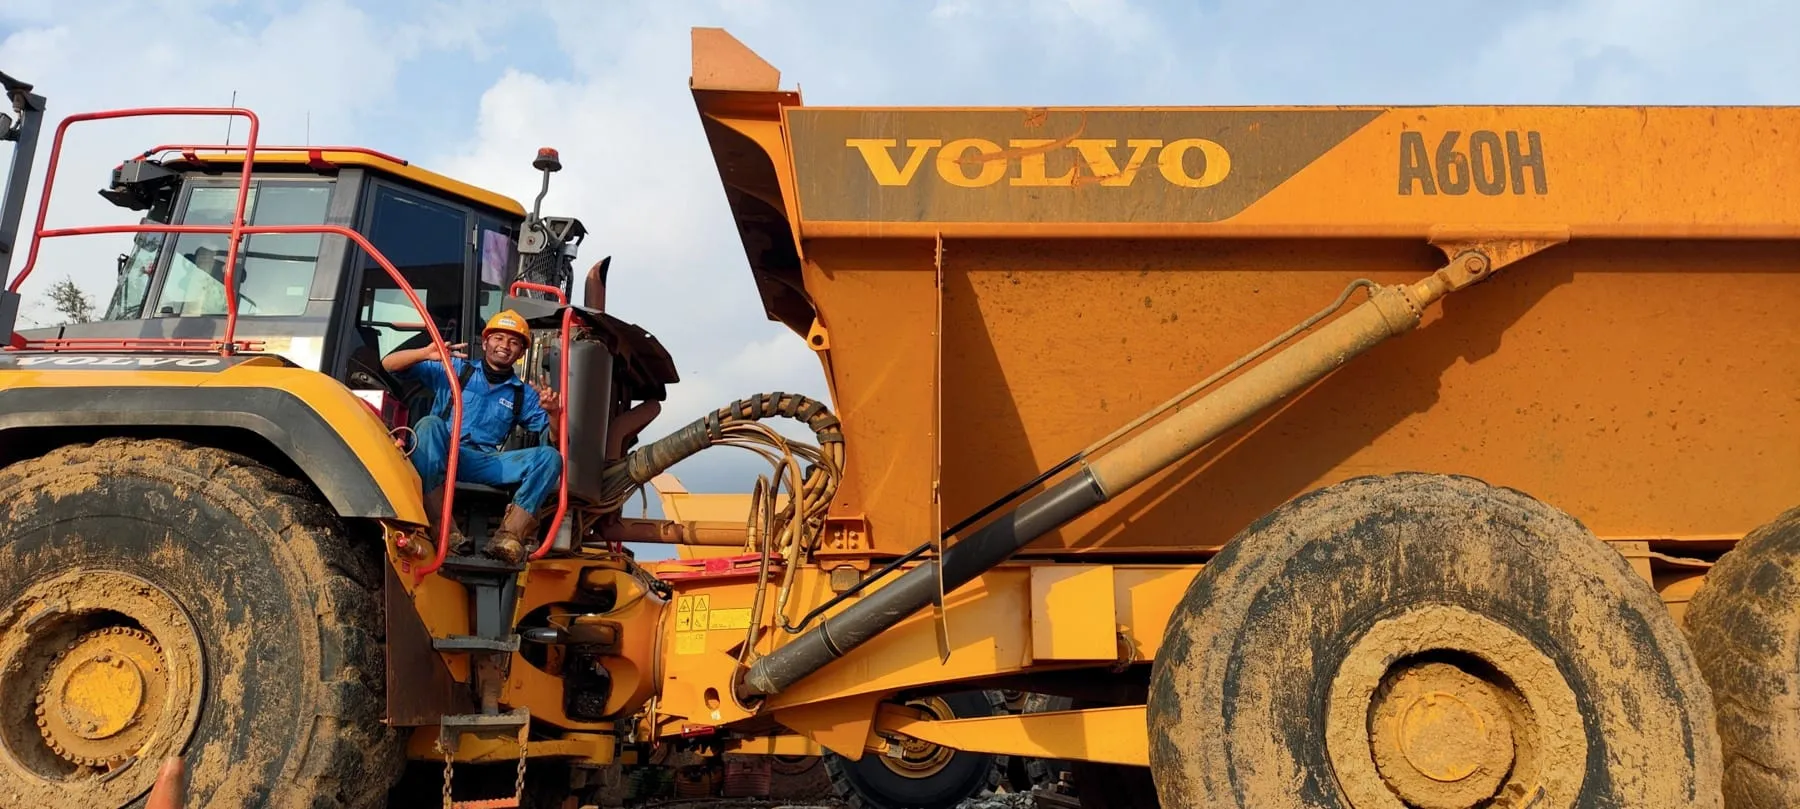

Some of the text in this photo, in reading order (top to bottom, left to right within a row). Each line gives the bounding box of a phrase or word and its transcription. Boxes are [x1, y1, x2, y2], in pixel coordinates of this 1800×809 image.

[846, 138, 1231, 187] VOLVO
[1398, 130, 1548, 195] A60H
[16, 356, 220, 367] VOLVO
